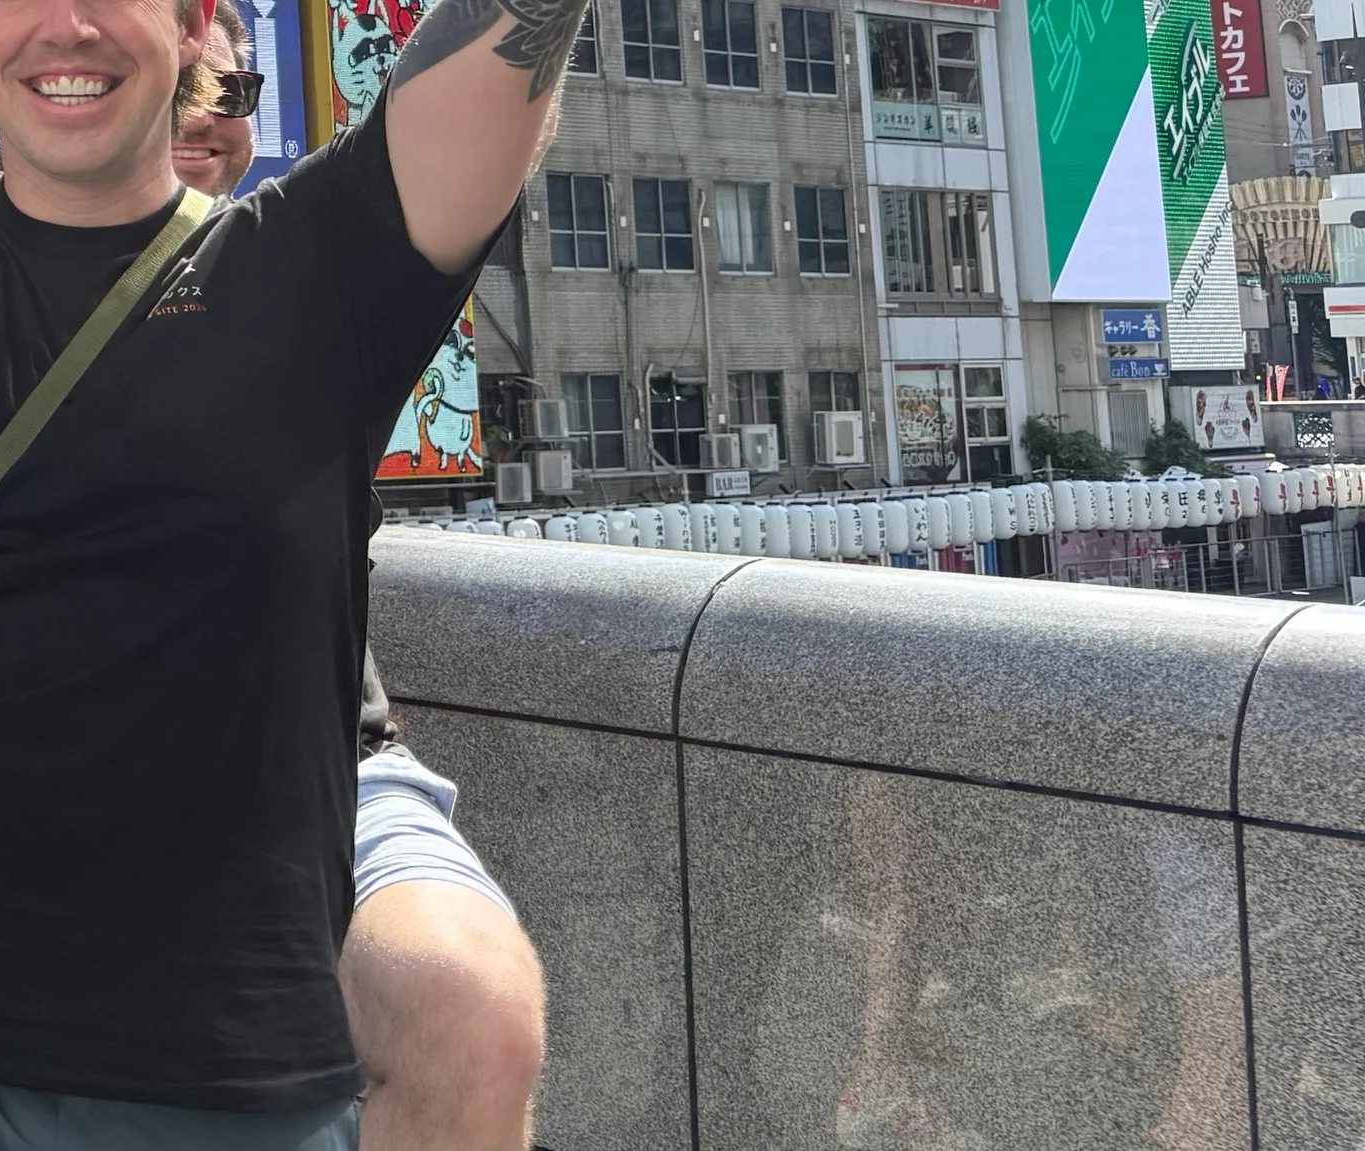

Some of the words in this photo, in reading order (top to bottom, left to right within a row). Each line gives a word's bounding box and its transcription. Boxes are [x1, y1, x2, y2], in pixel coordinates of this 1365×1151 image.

[1103, 320, 1140, 336] ギャラリー
[1129, 361, 1151, 378] Bon
